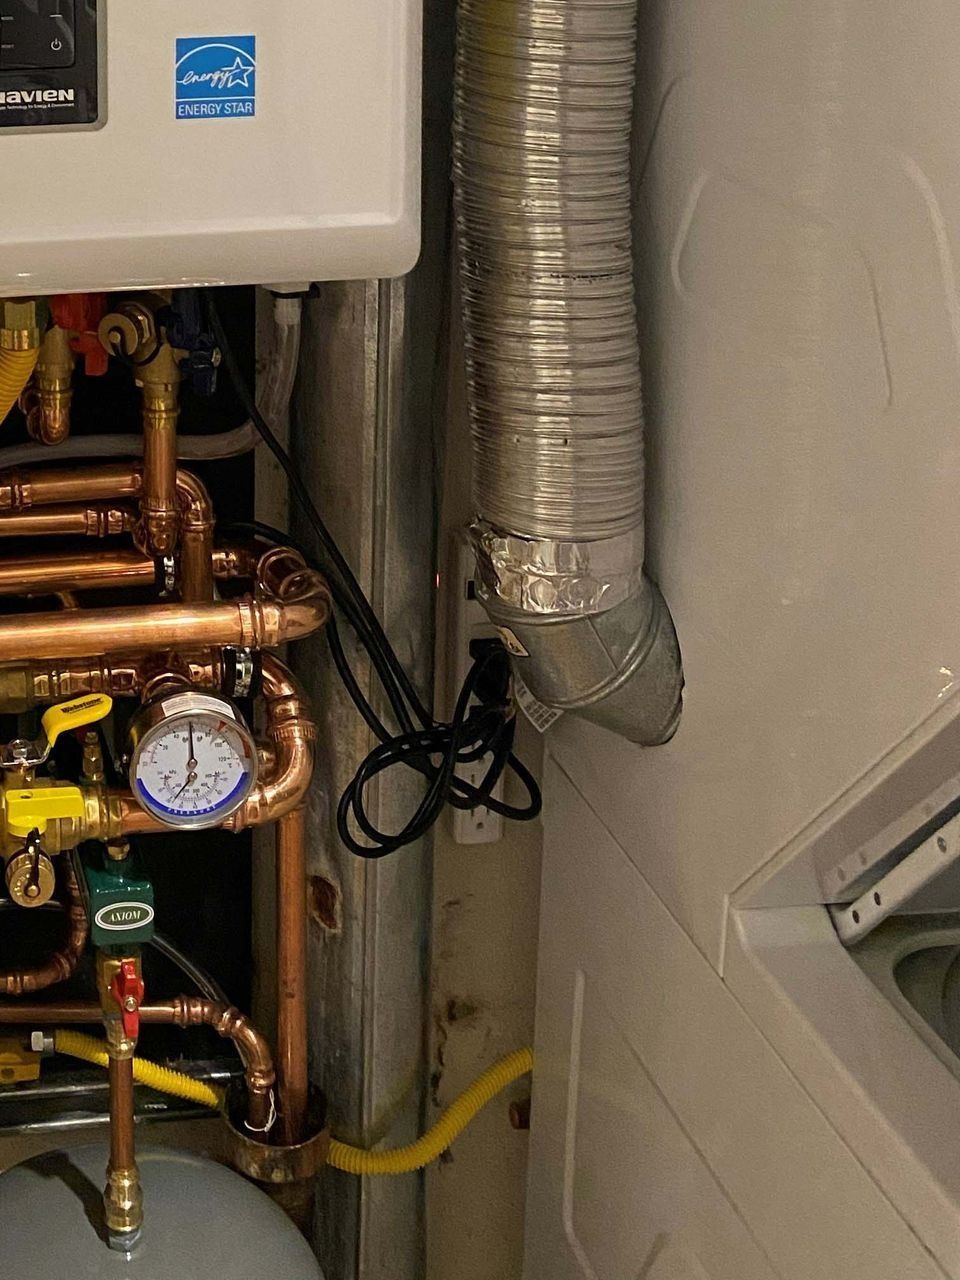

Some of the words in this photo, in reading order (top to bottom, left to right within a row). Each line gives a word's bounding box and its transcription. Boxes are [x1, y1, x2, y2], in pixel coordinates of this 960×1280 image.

[178, 103, 222, 116] ENERGY
[224, 101, 253, 114] STAR
[110, 910, 141, 922] AXIOM
